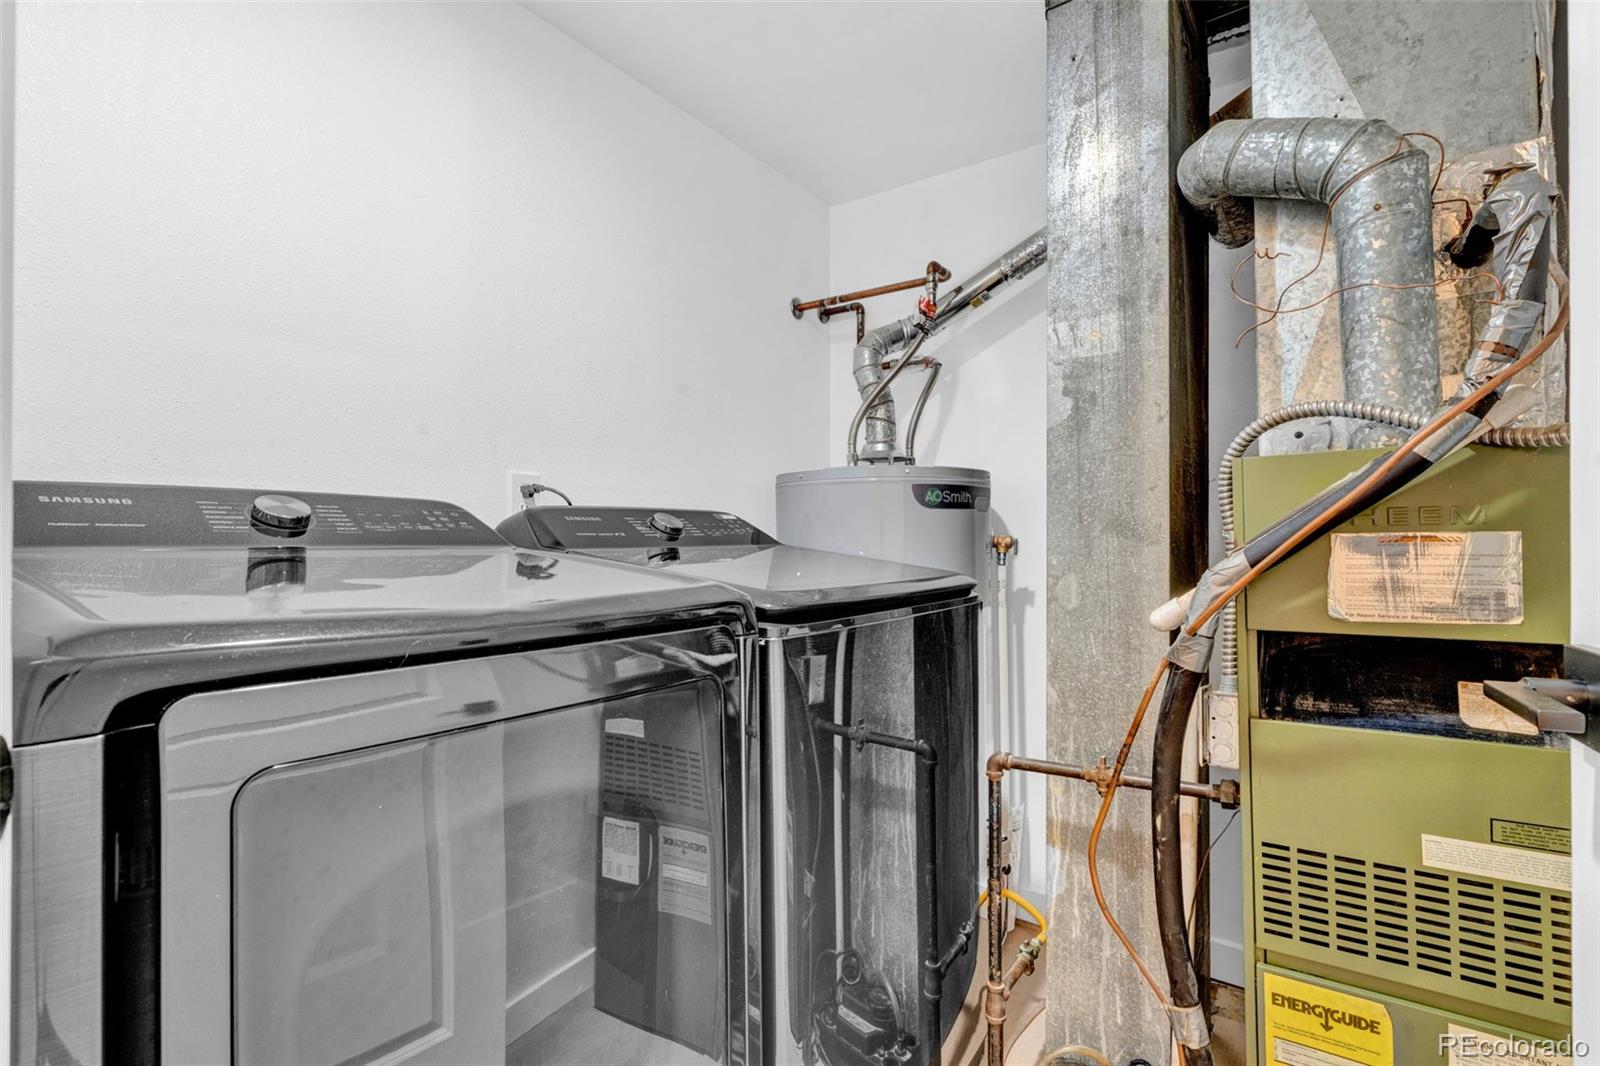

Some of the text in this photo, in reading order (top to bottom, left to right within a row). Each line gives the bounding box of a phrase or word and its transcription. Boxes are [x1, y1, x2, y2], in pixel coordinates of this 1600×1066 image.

[38, 495, 132, 504] SAMSUNG
[1350, 505, 1488, 526] HEEM
[1271, 991, 1381, 1035] ENERGYGUIDE
